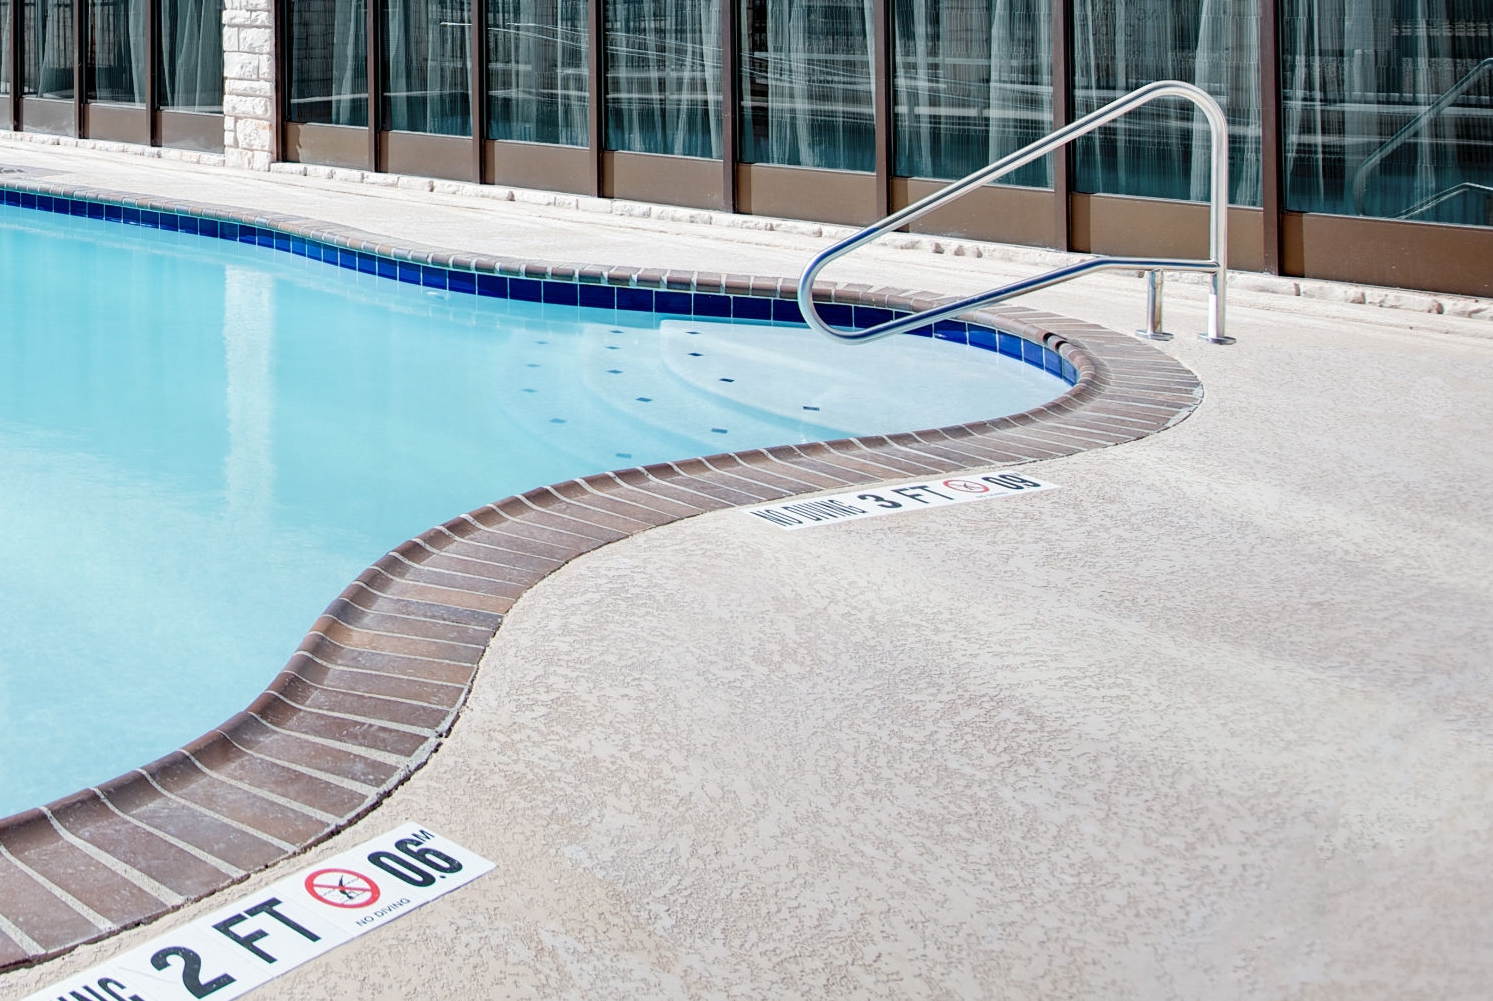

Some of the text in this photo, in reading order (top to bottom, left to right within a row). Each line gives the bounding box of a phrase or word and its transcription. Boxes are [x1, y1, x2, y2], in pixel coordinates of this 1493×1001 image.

[750, 509, 803, 526] NO
[781, 499, 867, 521] DIVING
[857, 494, 902, 508] 3
[890, 485, 954, 503] FT
[356, 897, 410, 927] NO DIVING
[150, 946, 237, 999] 2
[211, 897, 322, 964] FT
